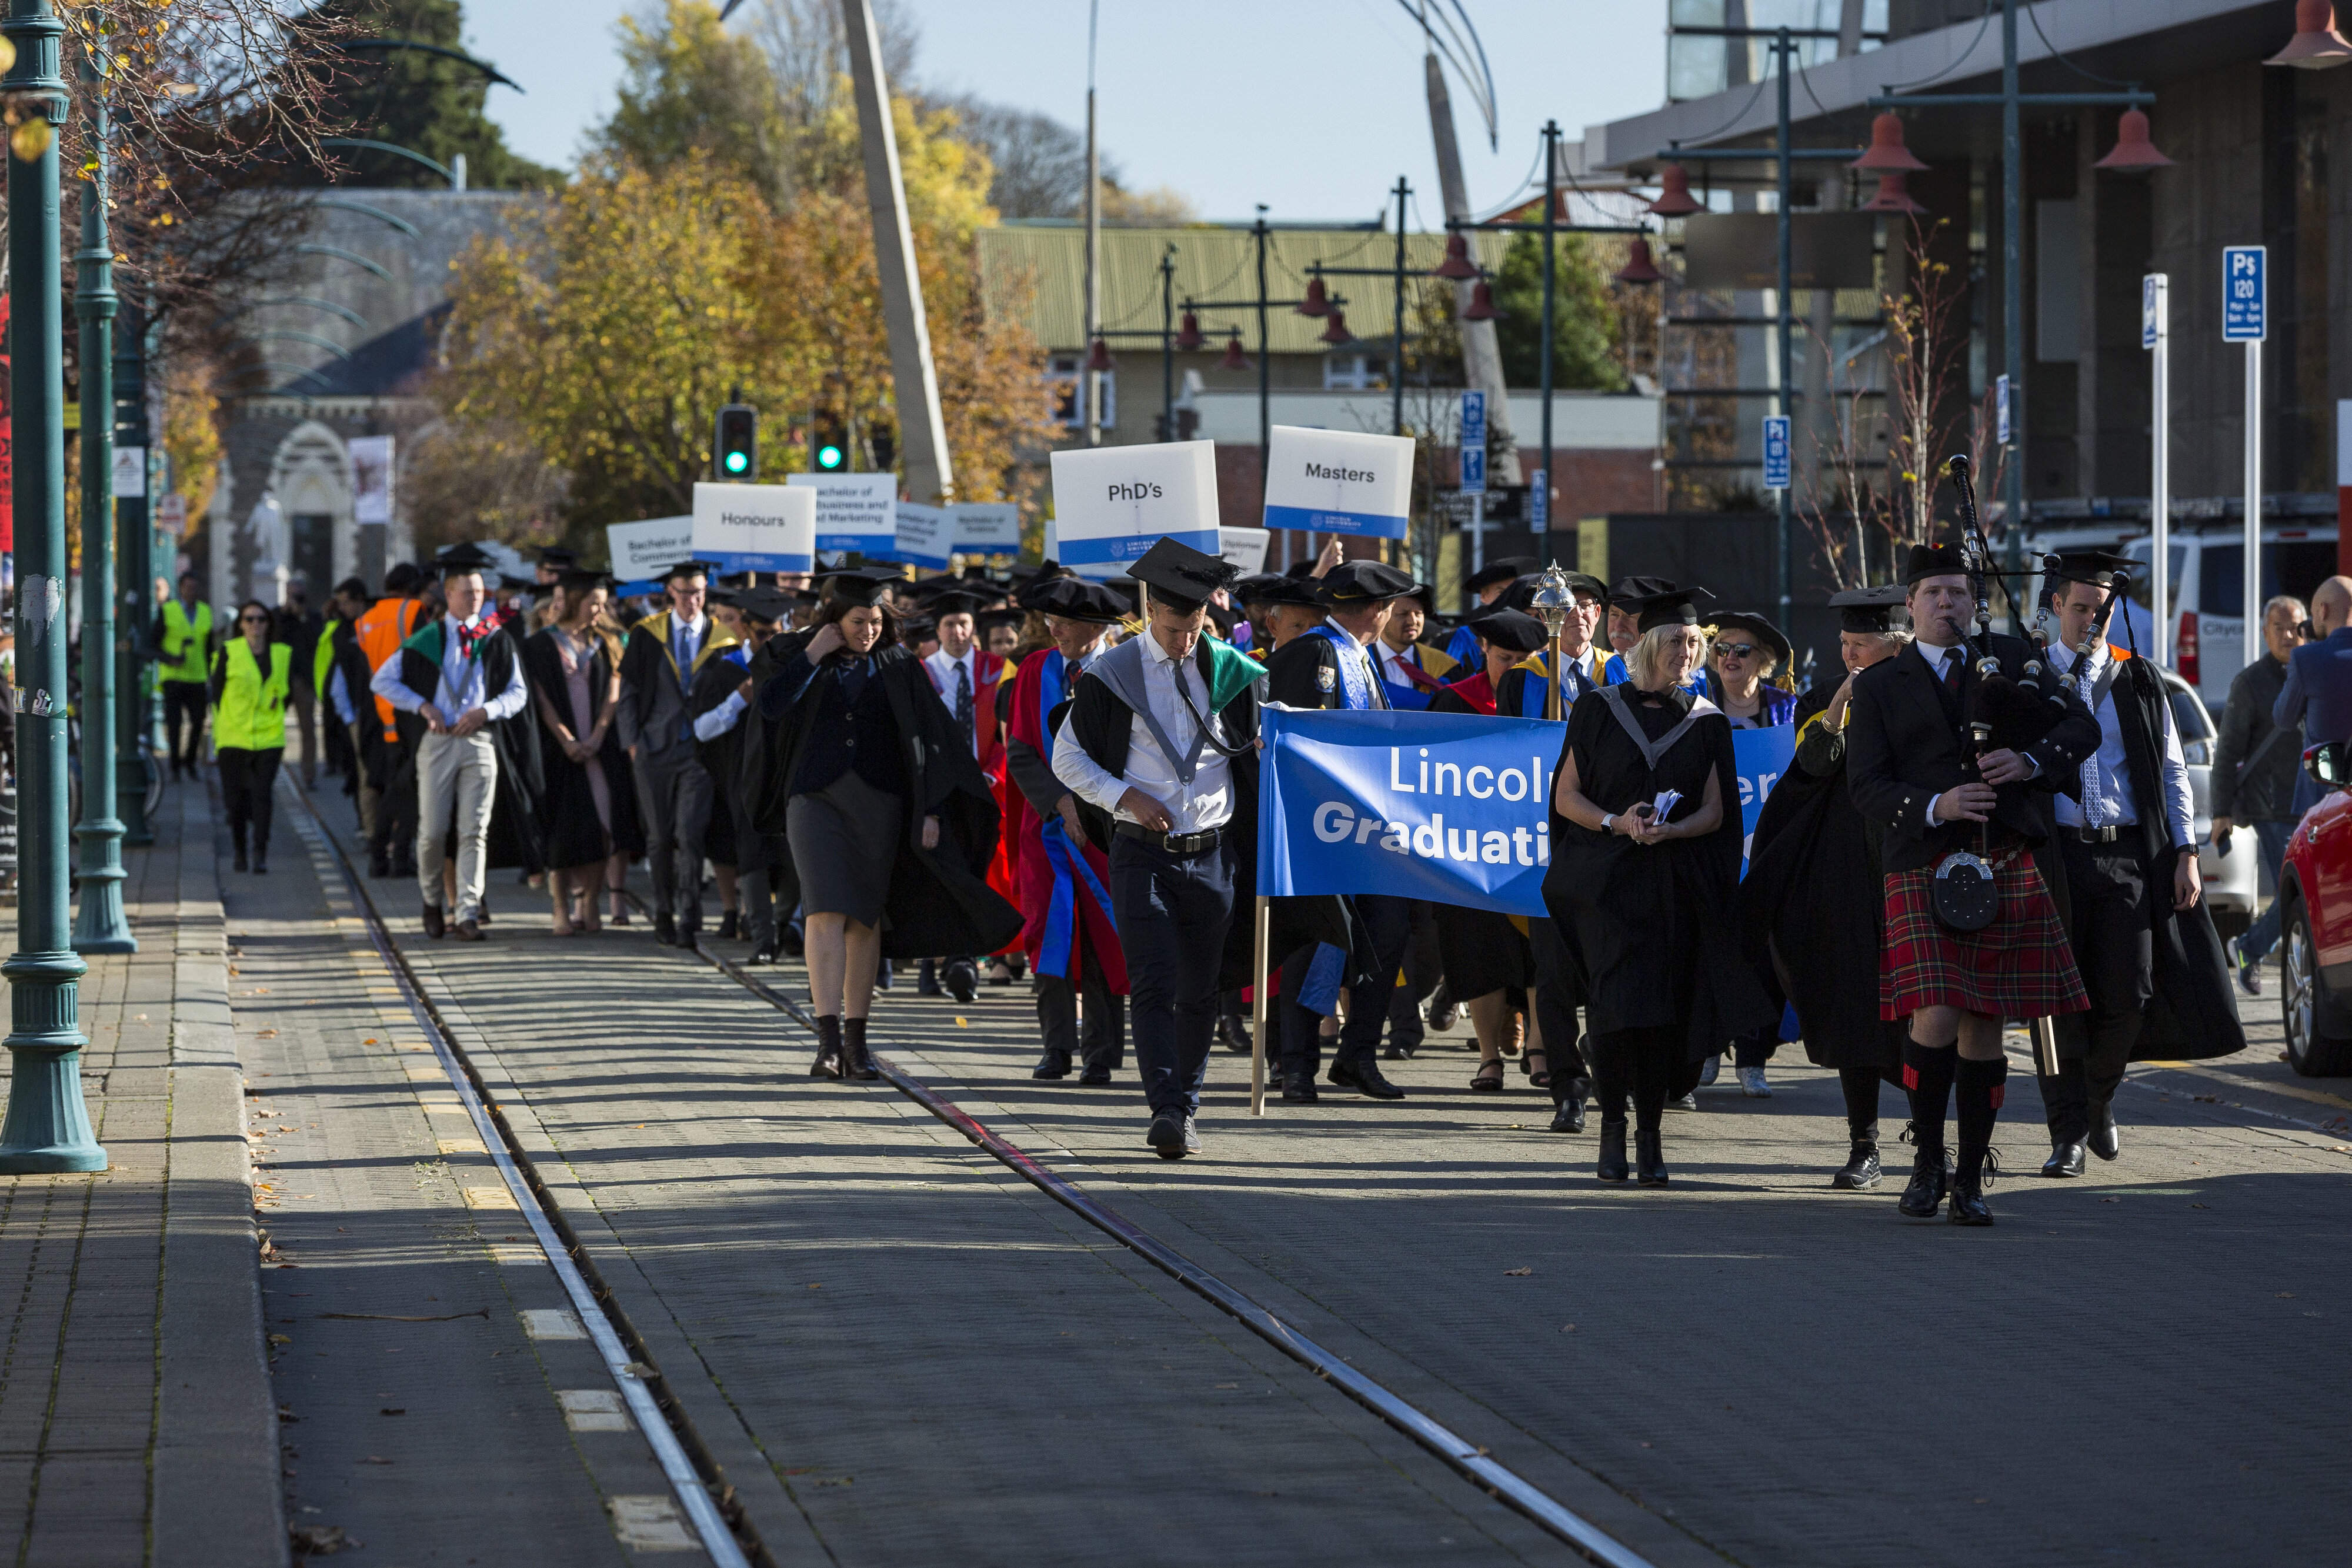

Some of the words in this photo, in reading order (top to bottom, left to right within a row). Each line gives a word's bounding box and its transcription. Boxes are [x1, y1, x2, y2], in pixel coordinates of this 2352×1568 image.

[2234, 279, 2254, 298] 120
[1306, 462, 1375, 483] Masters
[816, 487, 858, 496] achelor
[860, 486, 872, 496] of
[1109, 482, 1162, 501] PhD's
[867, 500, 889, 511] and
[721, 512, 785, 527] Honours
[828, 513, 884, 526] Marketing
[628, 537, 676, 551] Bachelor
[1391, 746, 1553, 803] Lincol
[1313, 801, 1549, 867] Graduati
